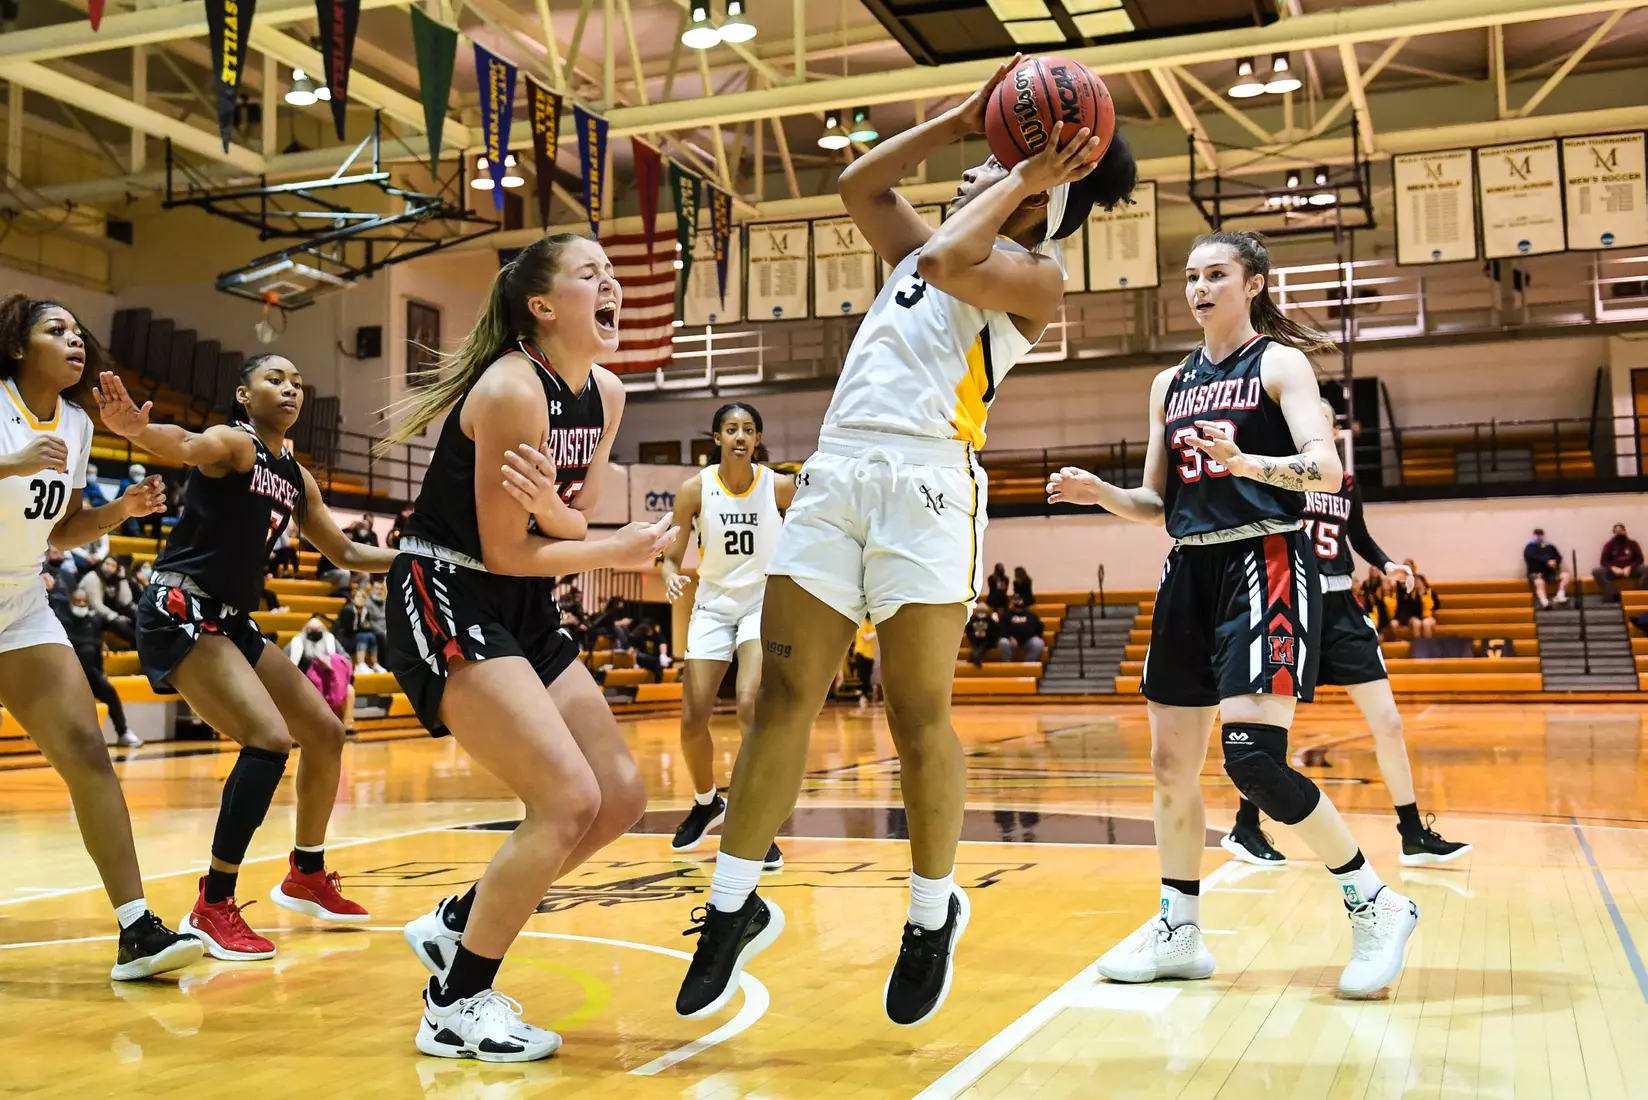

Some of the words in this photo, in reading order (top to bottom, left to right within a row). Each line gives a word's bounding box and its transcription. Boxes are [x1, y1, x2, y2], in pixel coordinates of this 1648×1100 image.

[221, 0, 239, 87] SVILLE
[332, 0, 346, 99] NSFIELD
[1013, 66, 1049, 153] Wilson
[1050, 65, 1082, 124] NCAA
[545, 94, 556, 160] SETON
[587, 118, 600, 222] SHEPHERD
[1601, 172, 1642, 182] SOCCER
[895, 269, 927, 310] 3
[23, 478, 66, 520] 30
[718, 512, 759, 527] VILLE
[1303, 490, 1351, 521] NSFIELD
[723, 529, 755, 556] 20
[1267, 635, 1295, 666] M
